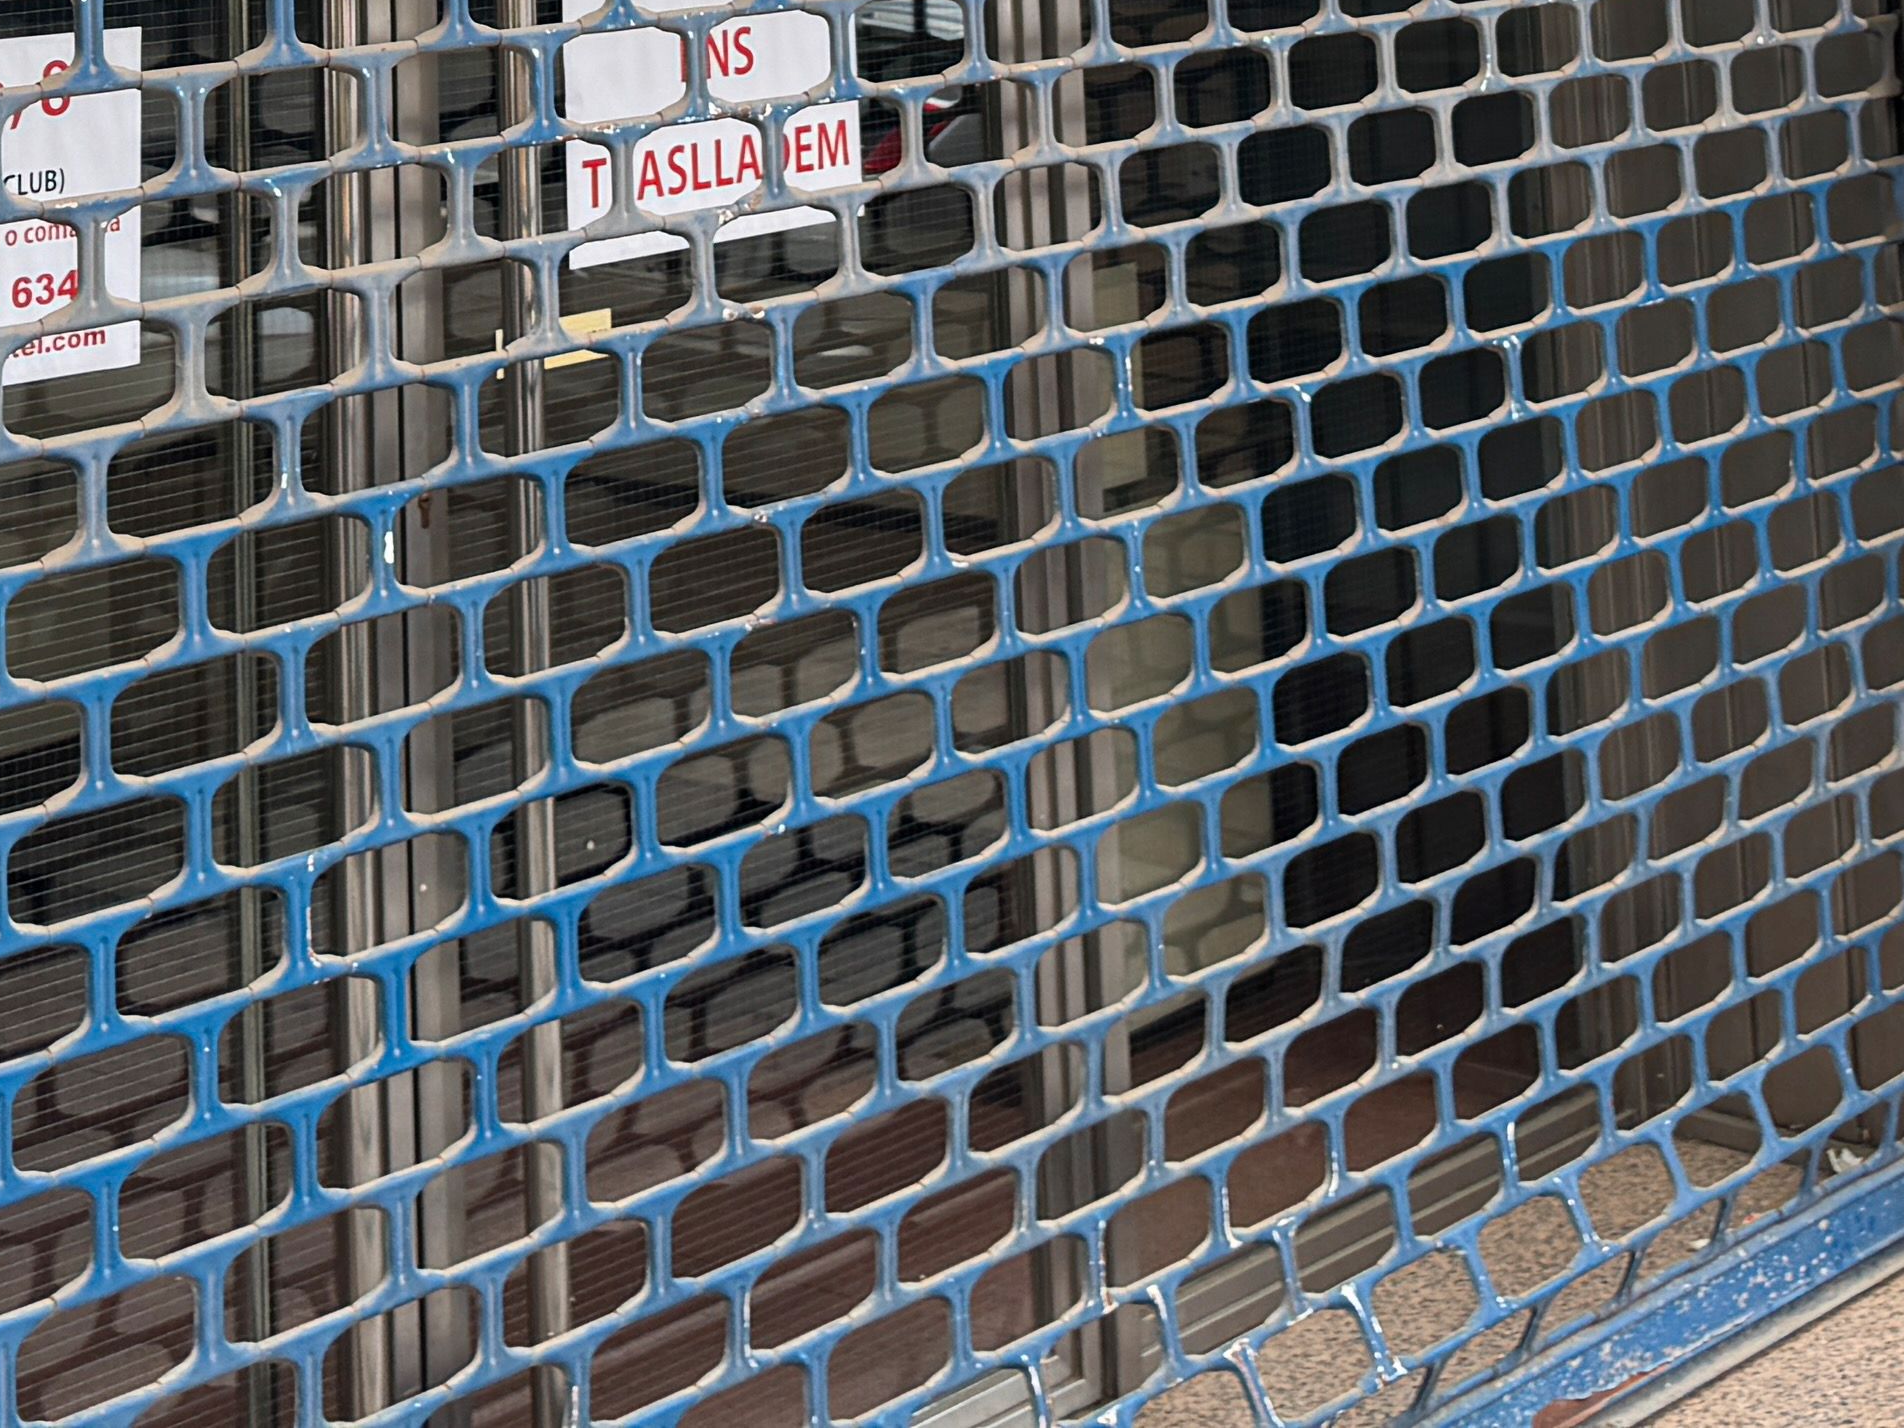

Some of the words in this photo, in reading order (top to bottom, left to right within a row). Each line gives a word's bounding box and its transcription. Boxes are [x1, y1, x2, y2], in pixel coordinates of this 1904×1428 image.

[680, 26, 754, 82] NS
[582, 119, 850, 209] TASLLAEM
[5, 230, 17, 246] o
[11, 270, 80, 309] 634
